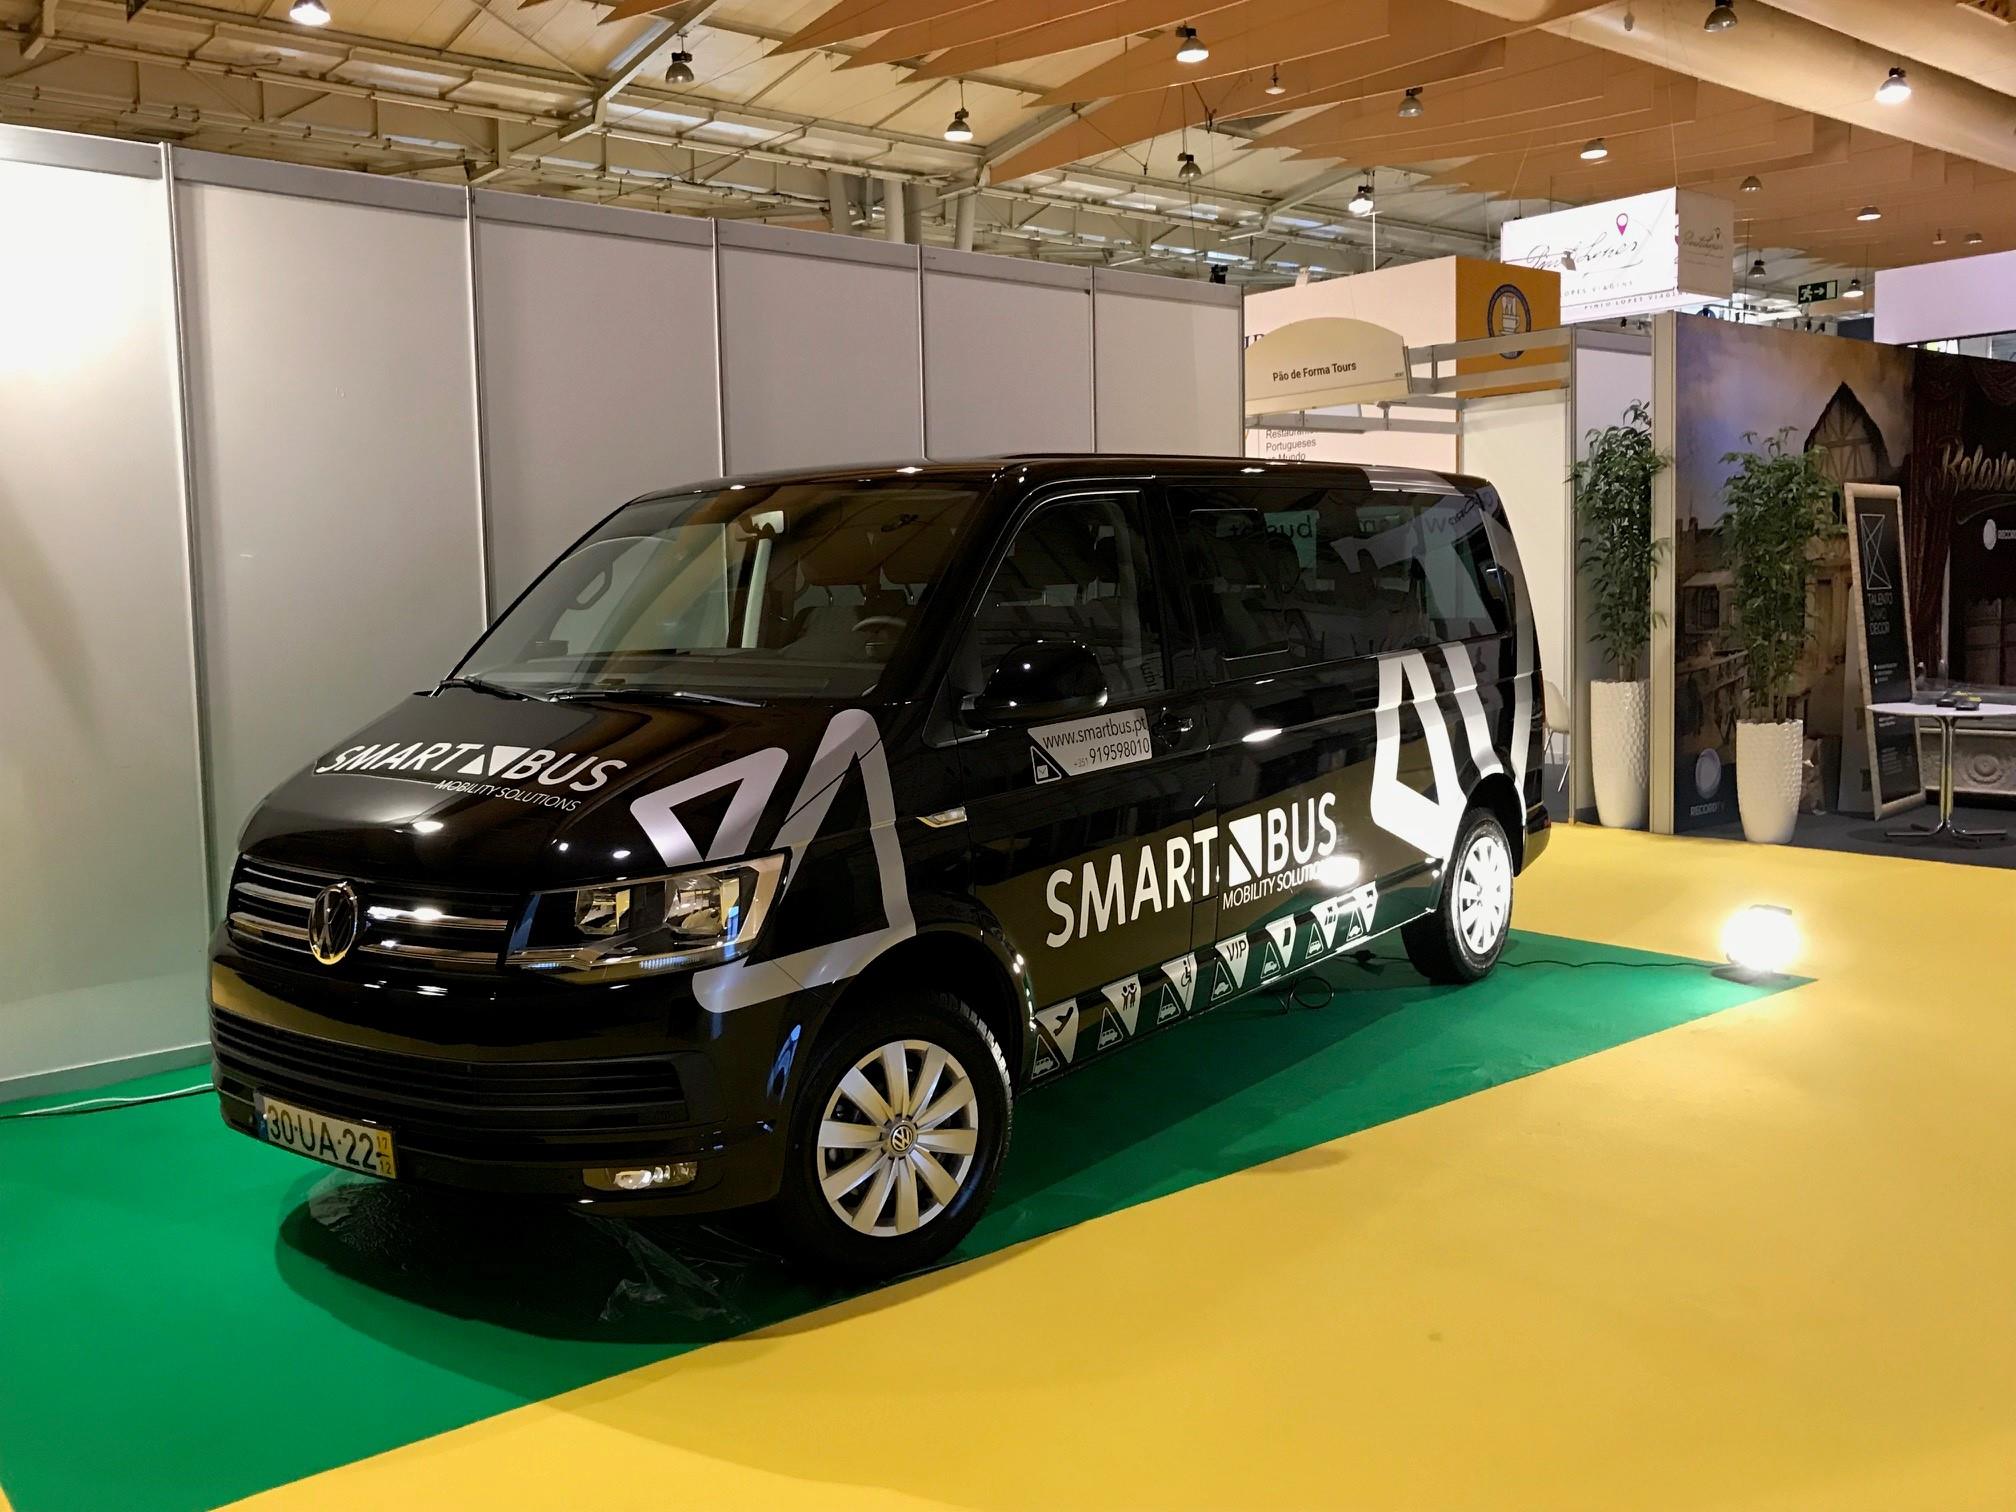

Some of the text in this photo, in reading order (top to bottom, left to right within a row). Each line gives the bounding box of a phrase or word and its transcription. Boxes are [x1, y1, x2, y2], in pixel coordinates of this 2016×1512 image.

[1272, 361, 1357, 382] Pão de Forma Tours
[1266, 438, 1317, 453] Portugueses
[1043, 717, 1149, 749] www.smartbus.pt
[316, 741, 628, 792] SMART BUS
[1073, 737, 1150, 768] +351 919598010
[435, 779, 582, 812] MOBILITY SOLUTIONS
[1046, 791, 1338, 948] SMART BUS
[1222, 874, 1276, 911] MOBILITY
[1226, 939, 1247, 962] VIP
[376, 1136, 388, 1150] 17
[380, 1161, 392, 1175] 12
